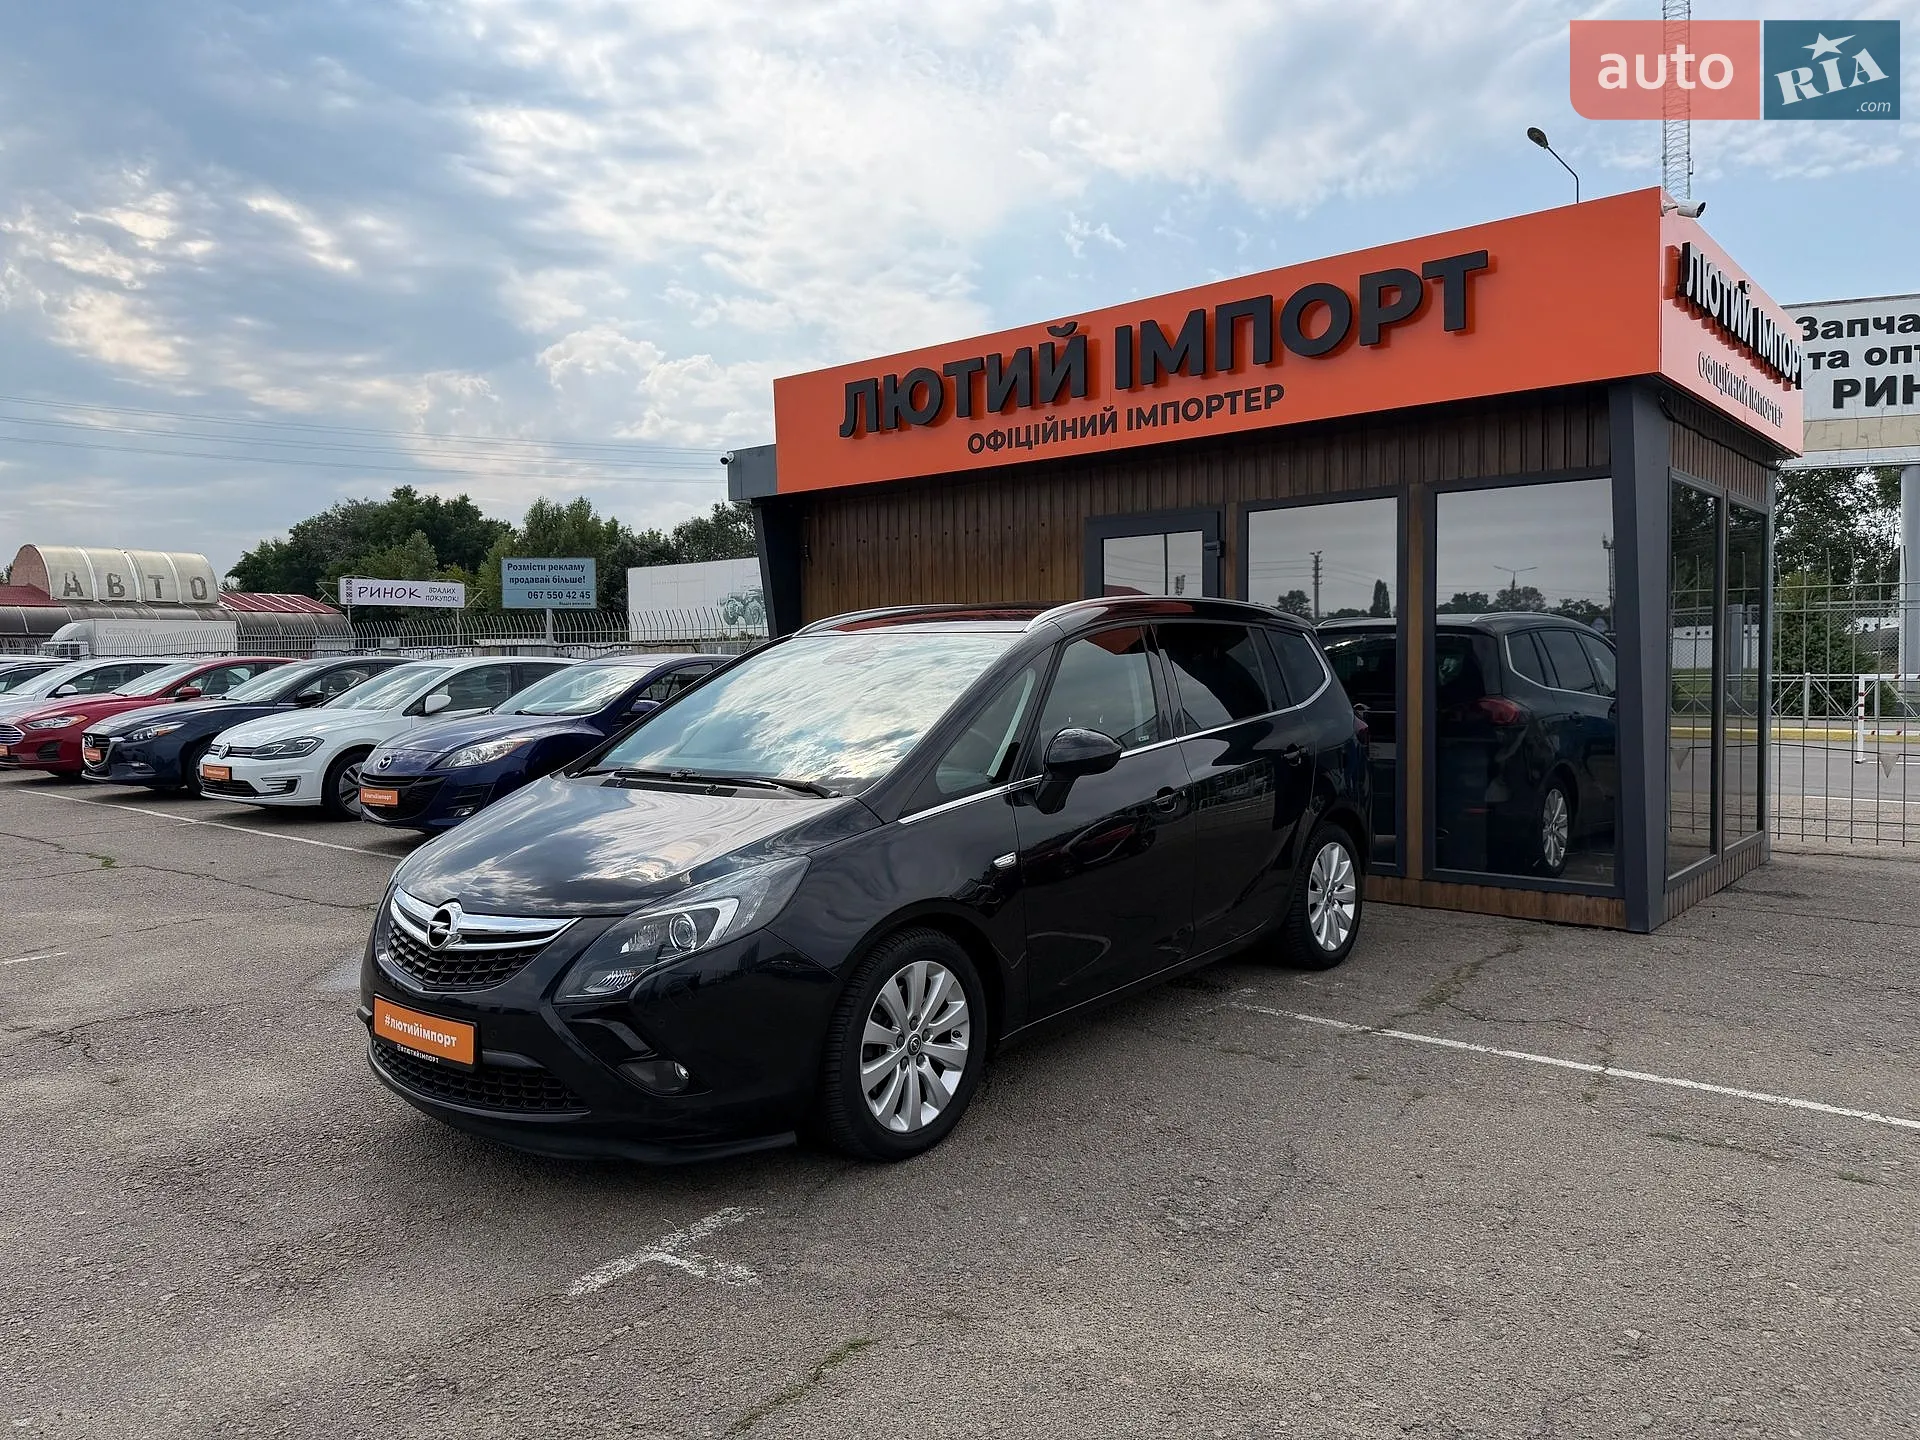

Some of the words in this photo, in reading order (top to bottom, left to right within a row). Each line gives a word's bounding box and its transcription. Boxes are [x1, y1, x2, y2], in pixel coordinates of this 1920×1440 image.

[1678, 241, 1753, 349] ЛЮТИЙ
[839, 321, 1089, 438] ЛЮТИЙ
[1114, 249, 1489, 391] ІМПОРТ
[1807, 350, 1850, 370] та
[966, 404, 1118, 455] ОФІЦІЙНИЙ
[1126, 383, 1285, 430] ІМПОРТЕР
[507, 563, 546, 571] Розмісти
[548, 563, 585, 572] рекламу
[509, 575, 550, 584] продавай
[552, 575, 586, 584] більше!
[358, 586, 421, 599] РИНОК
[527, 591, 544, 599] 067
[546, 591, 563, 599] 550
[565, 591, 577, 599] 42
[579, 591, 591, 599] 45
[384, 1014, 457, 1047] #лютийімпорт
